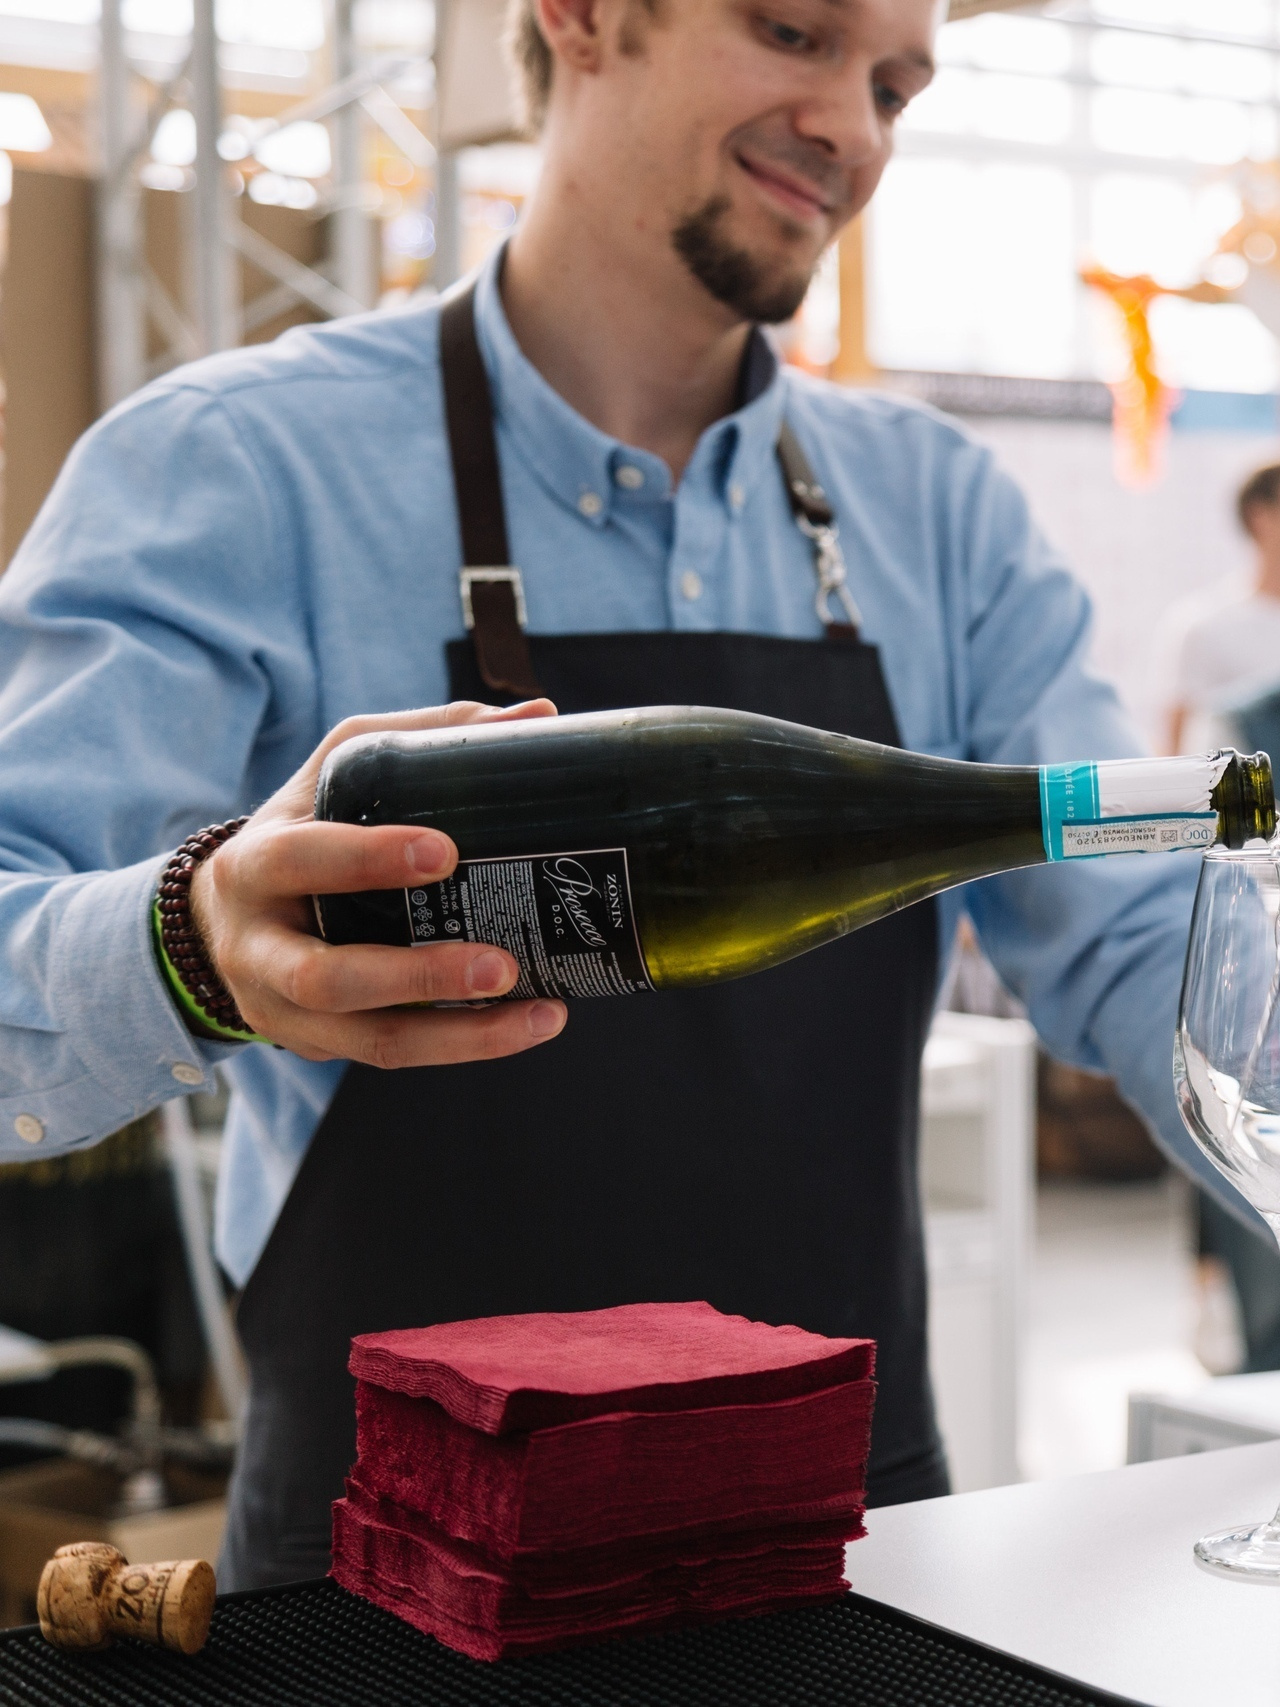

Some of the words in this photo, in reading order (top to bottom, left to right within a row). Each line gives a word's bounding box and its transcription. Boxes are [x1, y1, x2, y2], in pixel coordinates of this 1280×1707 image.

[1186, 830, 1208, 840] DOC
[459, 881, 470, 908] PRODUCED
[542, 857, 607, 947] Prosecco
[606, 873, 622, 929] ZONIN
[464, 916, 473, 930] CASA
[551, 904, 565, 939] D.O.C.
